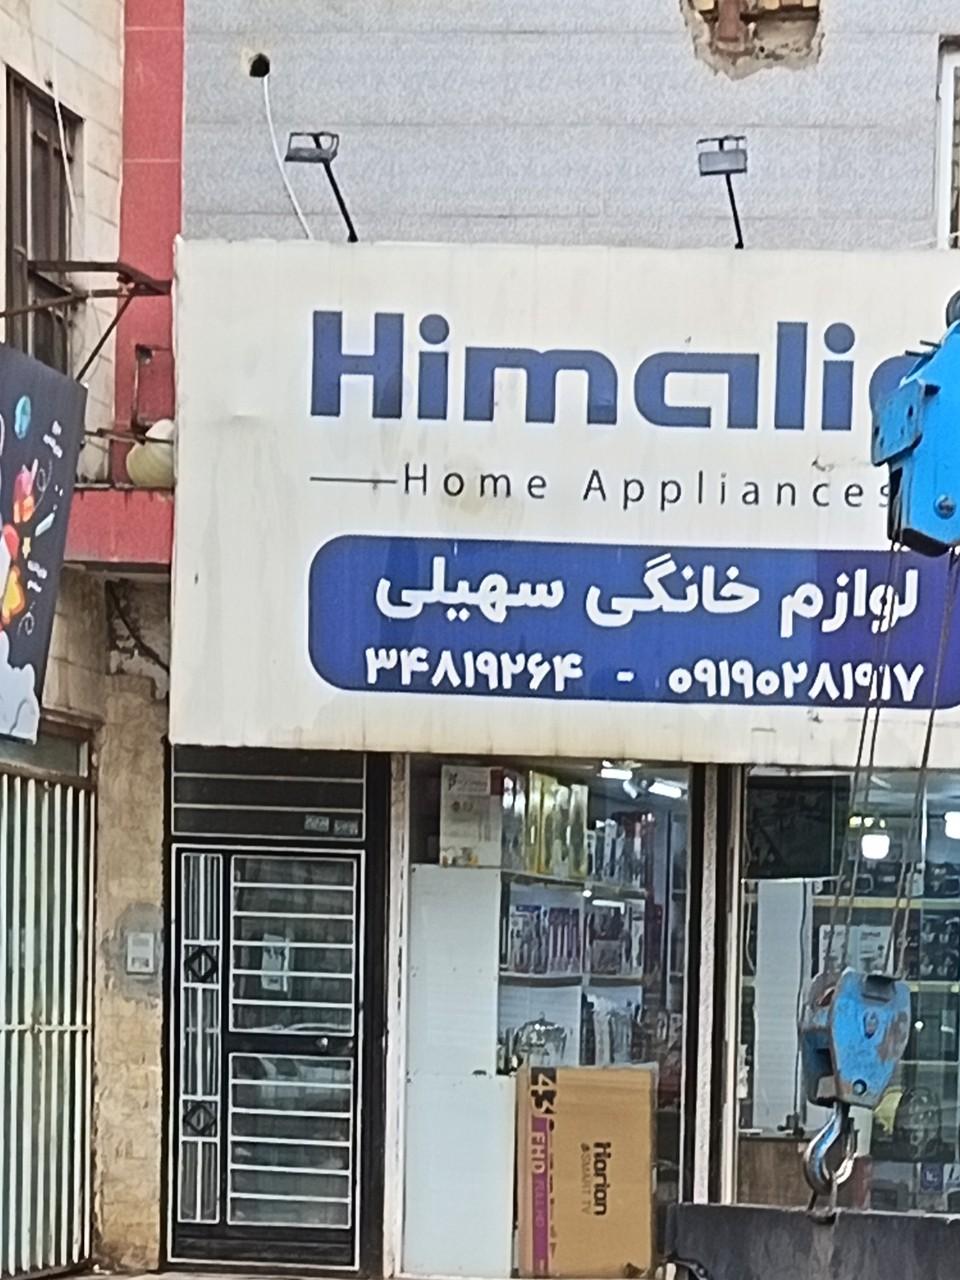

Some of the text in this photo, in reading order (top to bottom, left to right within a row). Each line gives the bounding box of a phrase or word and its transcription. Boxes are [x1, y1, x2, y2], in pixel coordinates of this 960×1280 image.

[307, 309, 921, 431] Himali
[404, 462, 547, 498] Home
[375, 553, 919, 638] لوازم خانگی سهیلی
[365, 647, 583, 692] ۳۴۸۱۹۲۶۴
